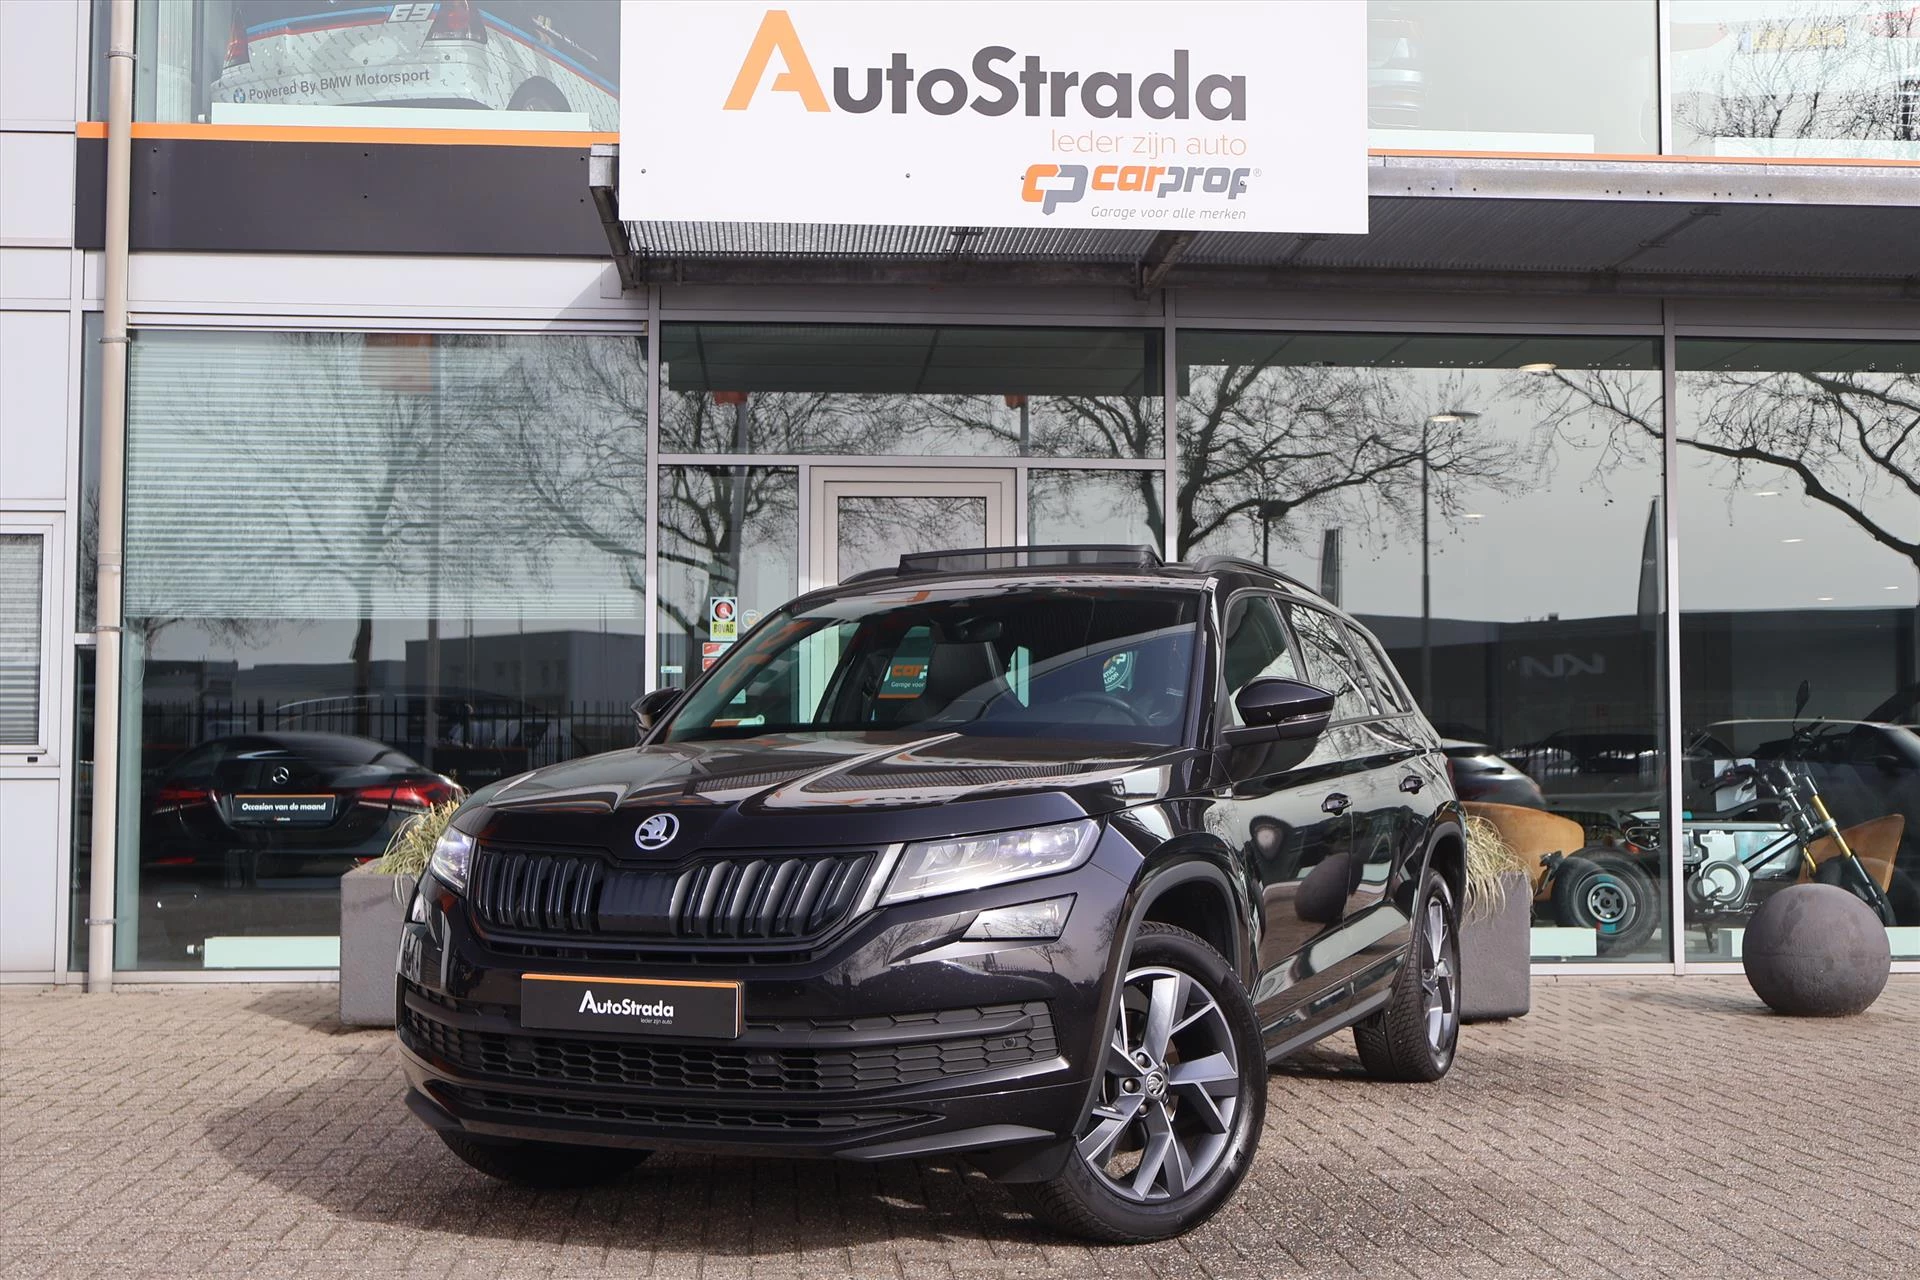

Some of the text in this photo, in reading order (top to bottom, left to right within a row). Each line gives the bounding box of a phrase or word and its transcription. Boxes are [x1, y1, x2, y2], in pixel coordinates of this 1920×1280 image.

[722, 9, 1247, 121] AutoStrada
[249, 69, 430, 100] Powered By BMW Motorsport
[1051, 129, 1247, 160] Ieder zijn auto
[1090, 205, 1246, 220] Garage voor alle merken
[713, 624, 734, 633] BOVAG
[242, 803, 273, 811] Occasion
[289, 803, 299, 811] de
[300, 802, 326, 811] maand
[578, 990, 674, 1017] AutoStrada
